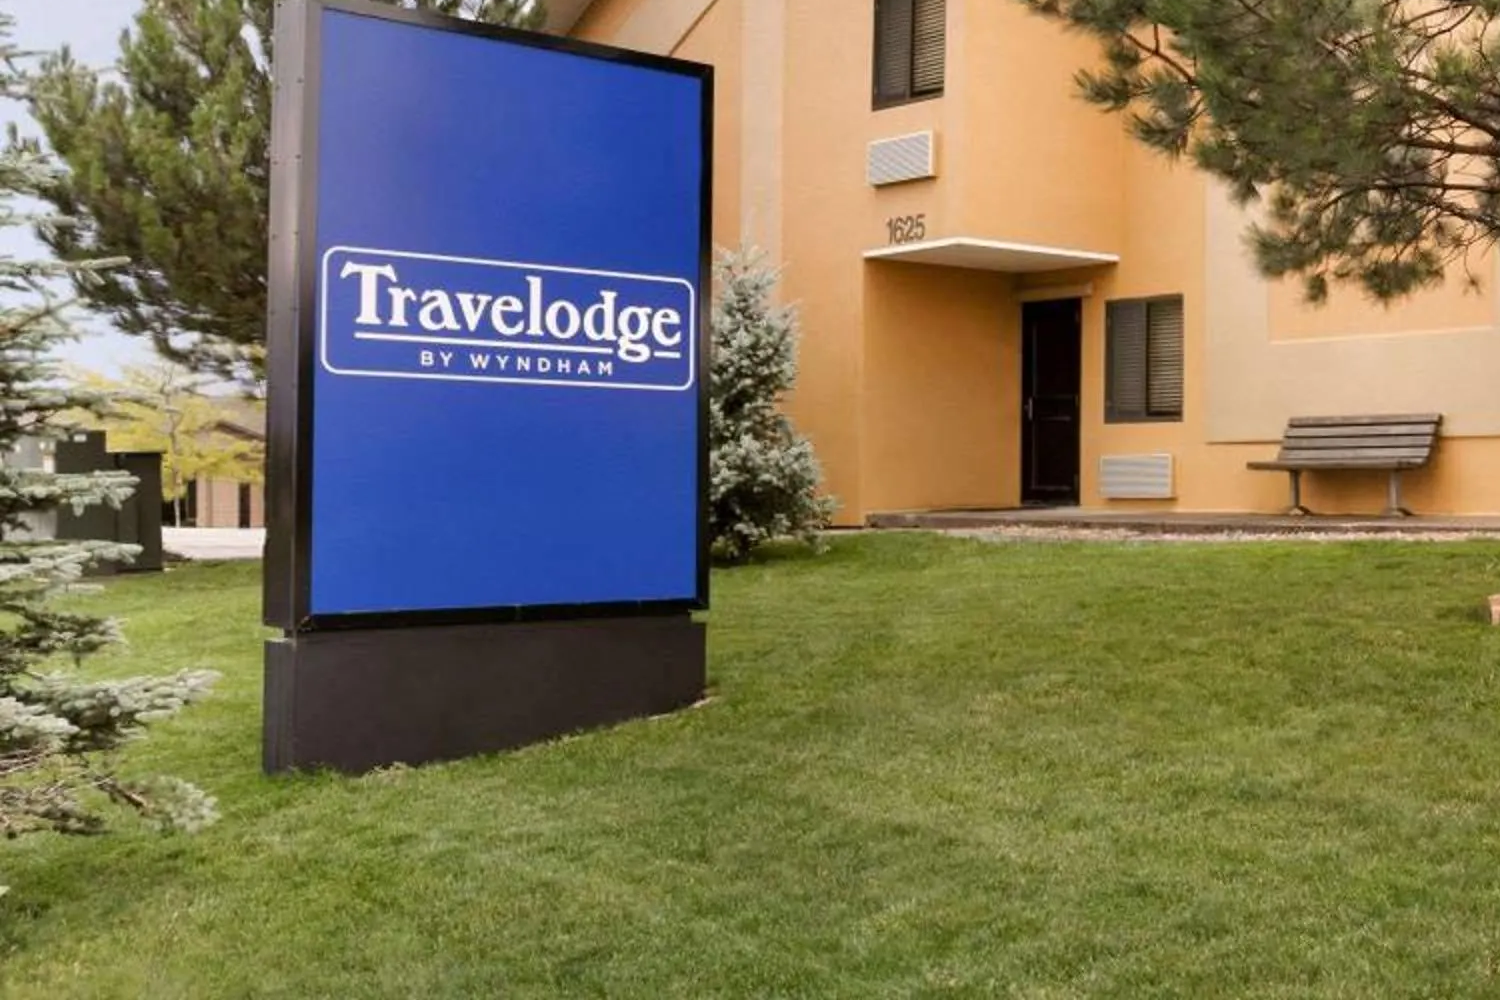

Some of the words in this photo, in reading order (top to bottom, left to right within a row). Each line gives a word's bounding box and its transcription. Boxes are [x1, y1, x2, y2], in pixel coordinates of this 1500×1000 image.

[886, 213, 926, 245] 1625
[340, 261, 681, 362] Travelodge
[420, 351, 453, 368] BY
[470, 353, 614, 376] WYNDHAM
